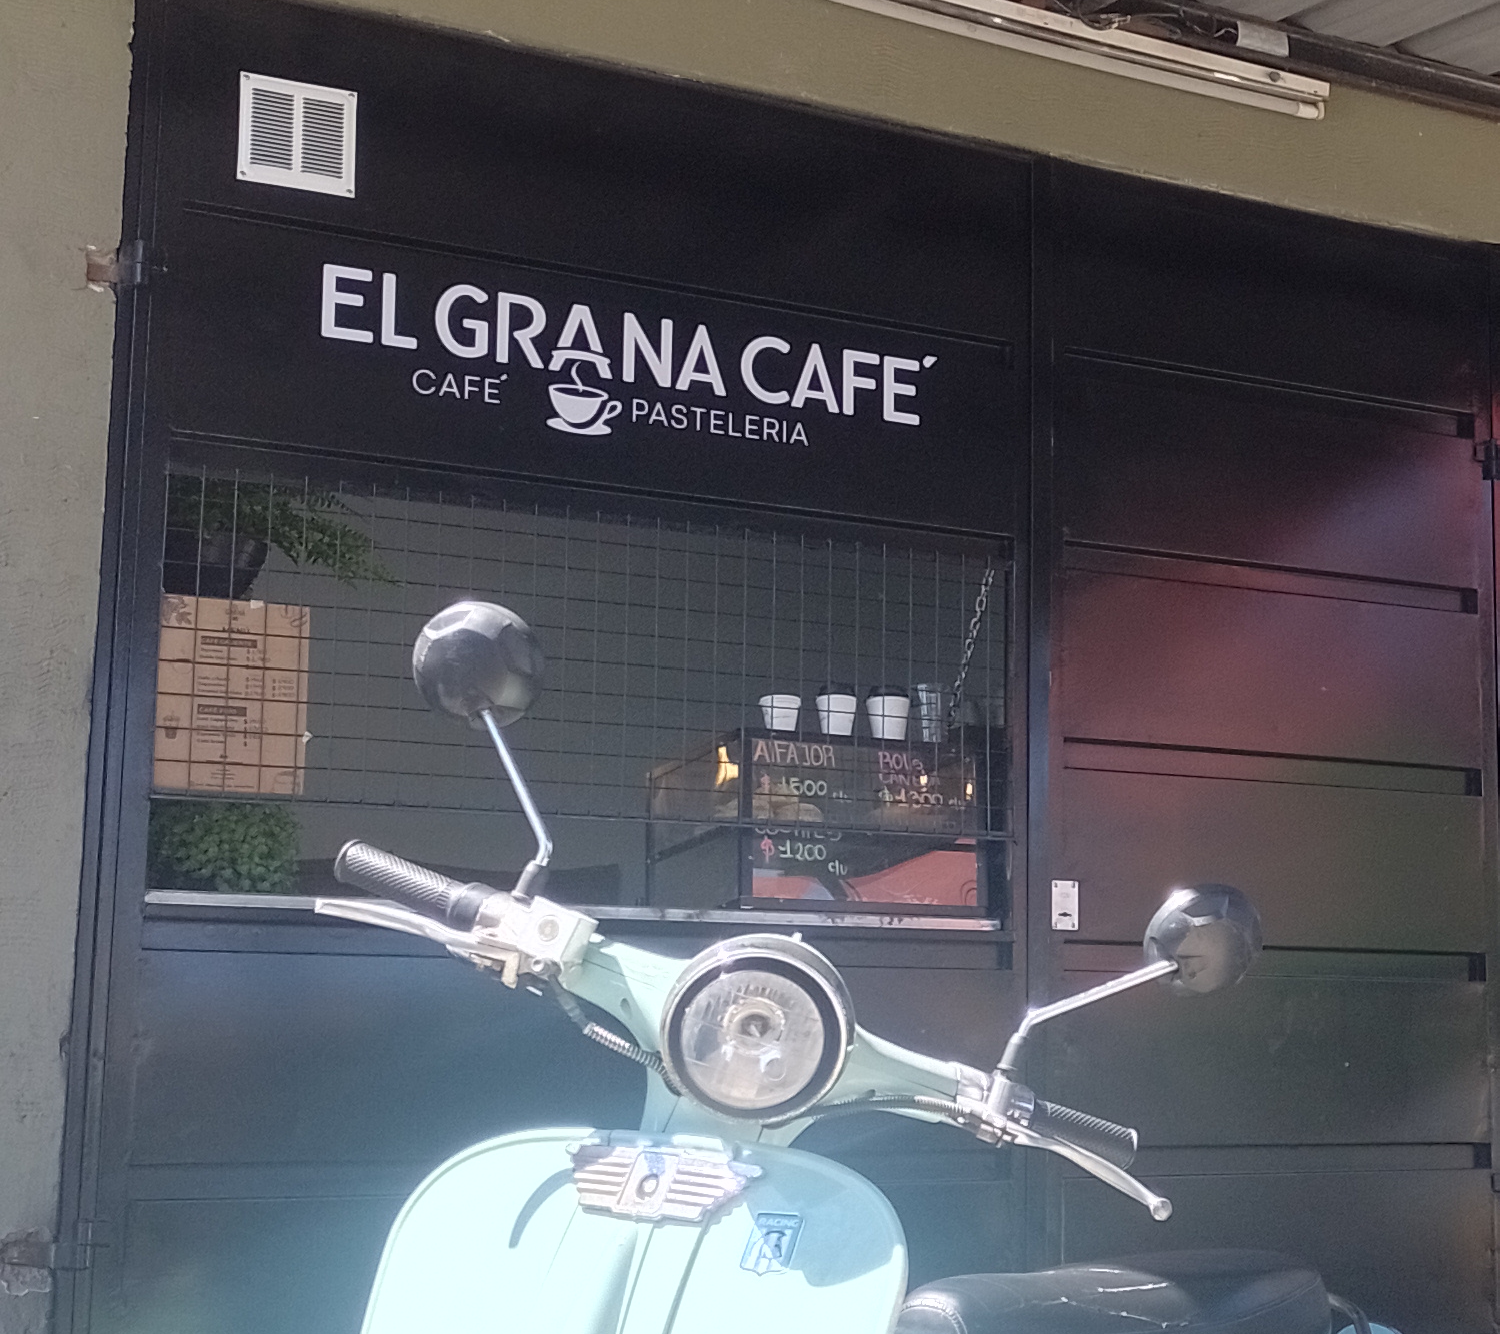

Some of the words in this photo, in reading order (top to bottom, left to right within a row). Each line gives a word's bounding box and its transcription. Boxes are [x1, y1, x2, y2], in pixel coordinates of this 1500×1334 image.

[321, 263, 418, 350] EL
[434, 283, 727, 398] GRANA
[631, 398, 809, 447] PASTELERIA
[757, 1216, 800, 1228] RACING
